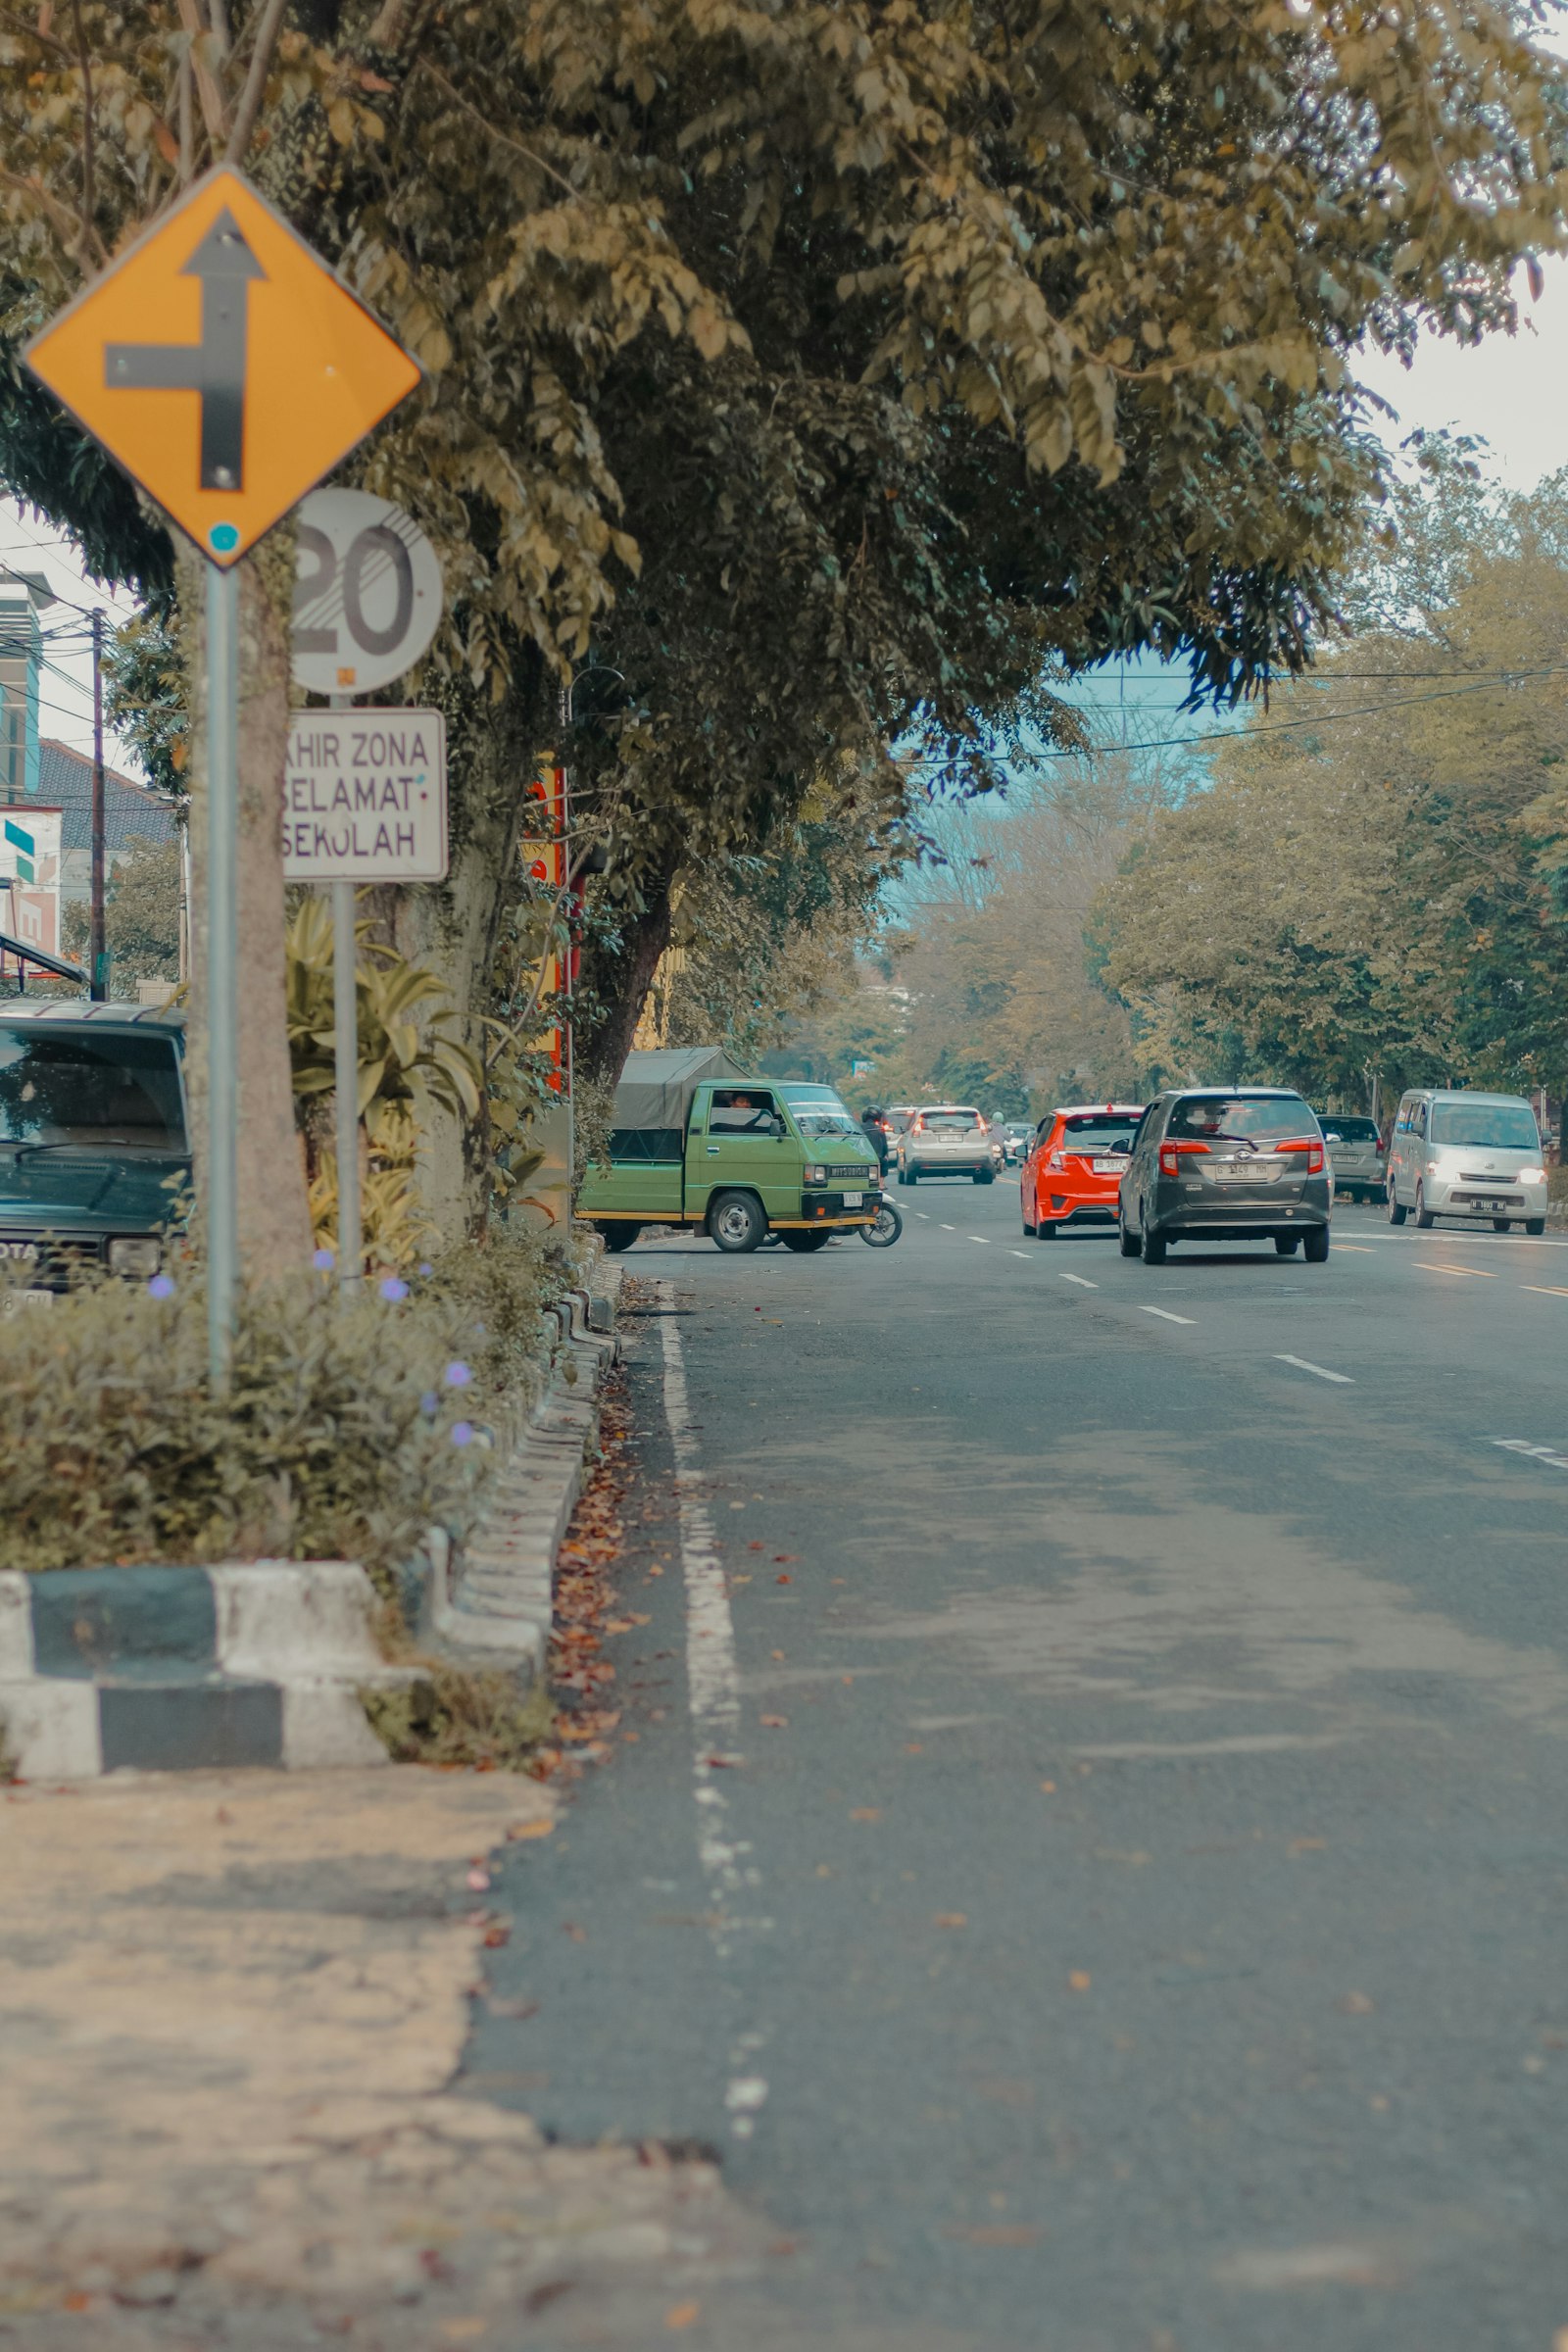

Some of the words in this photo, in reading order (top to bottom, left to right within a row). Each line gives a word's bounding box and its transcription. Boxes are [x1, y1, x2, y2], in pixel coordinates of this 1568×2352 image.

[291, 524, 414, 656] 20
[351, 732, 428, 766] ZONA
[1217, 1165, 1223, 1174] G
